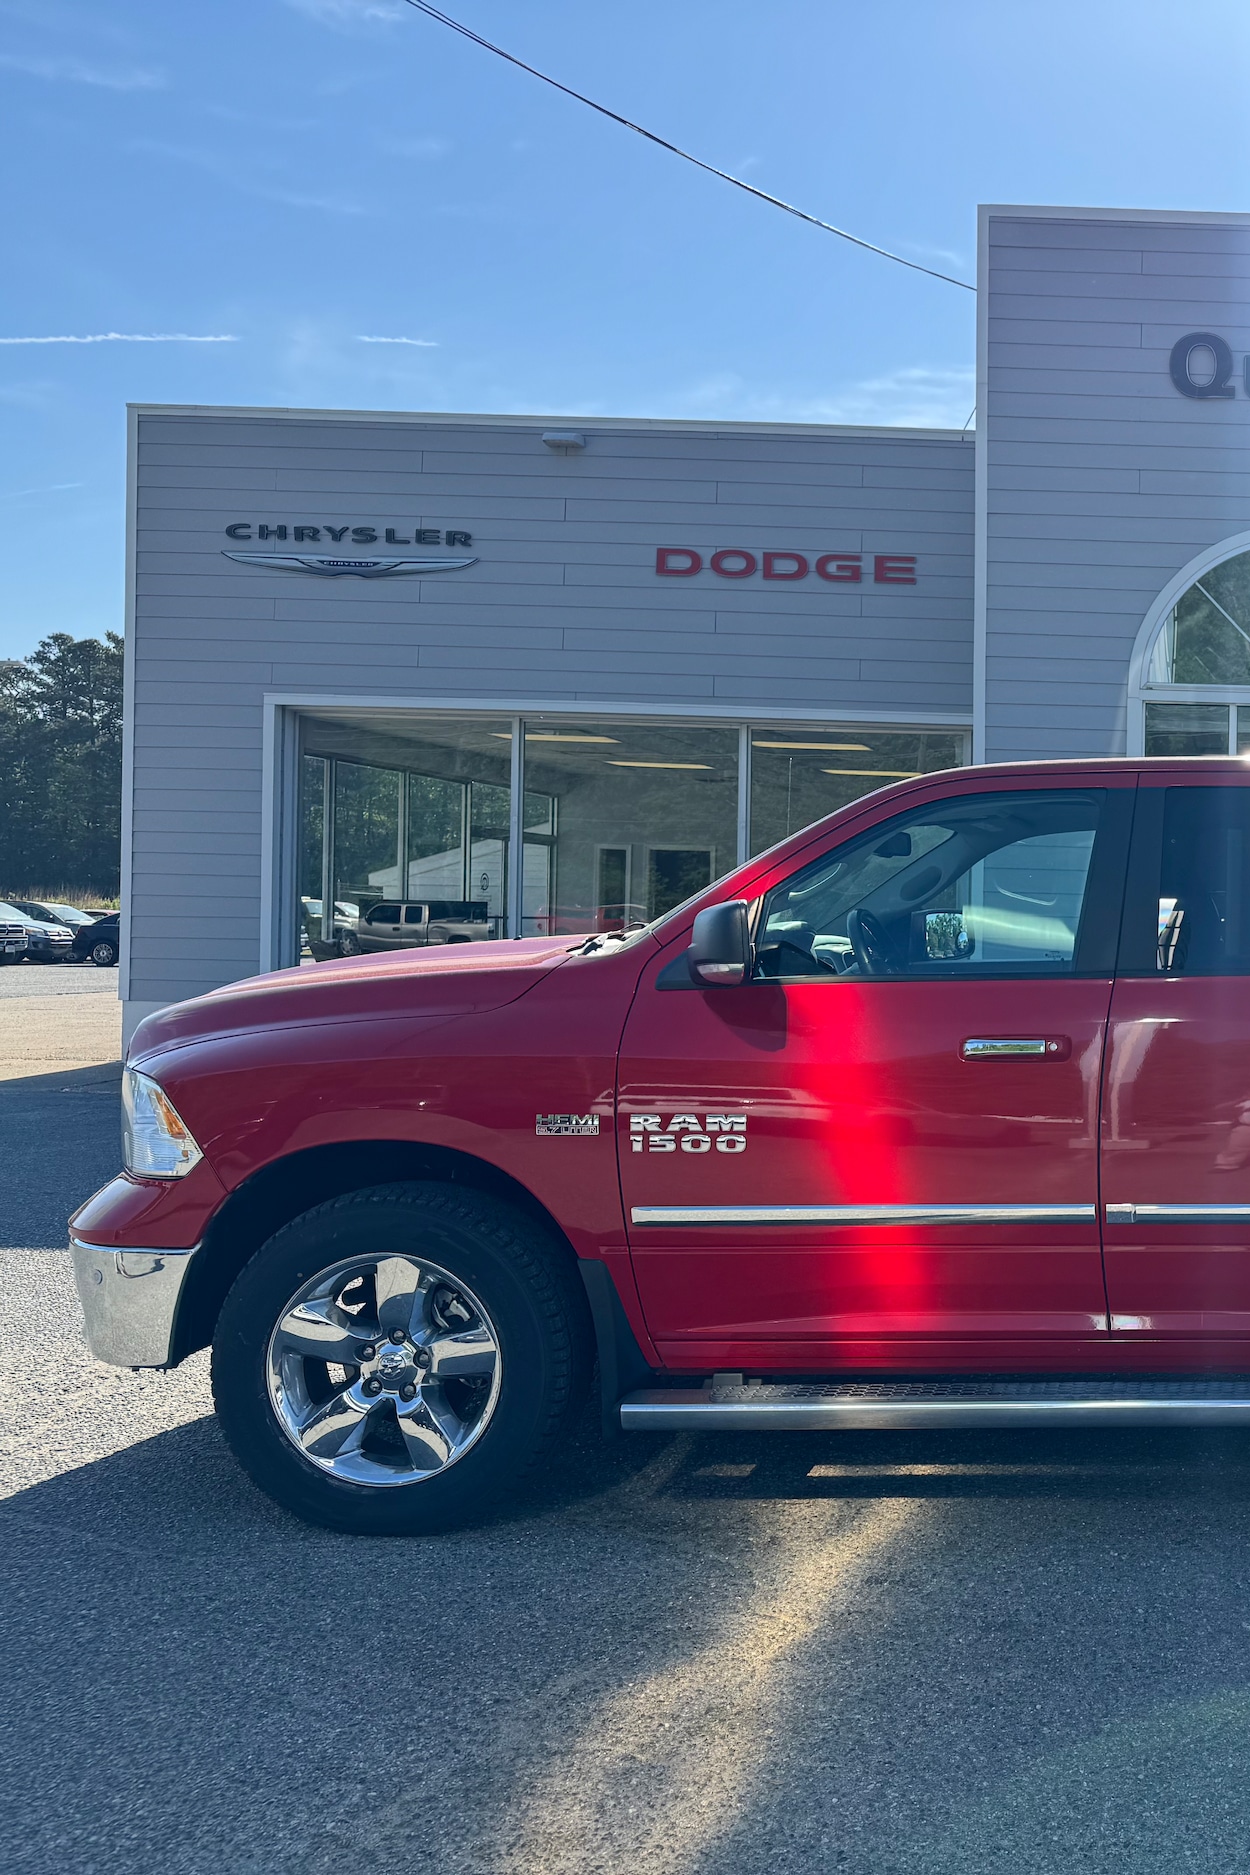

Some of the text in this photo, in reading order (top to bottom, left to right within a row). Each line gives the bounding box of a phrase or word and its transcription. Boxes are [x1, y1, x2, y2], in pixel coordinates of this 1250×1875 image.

[225, 523, 472, 547] CHRYSLER
[656, 548, 917, 585] DODGE
[536, 1114, 599, 1125] HEMI
[630, 1114, 747, 1132] RAM
[630, 1135, 747, 1153] 1500
